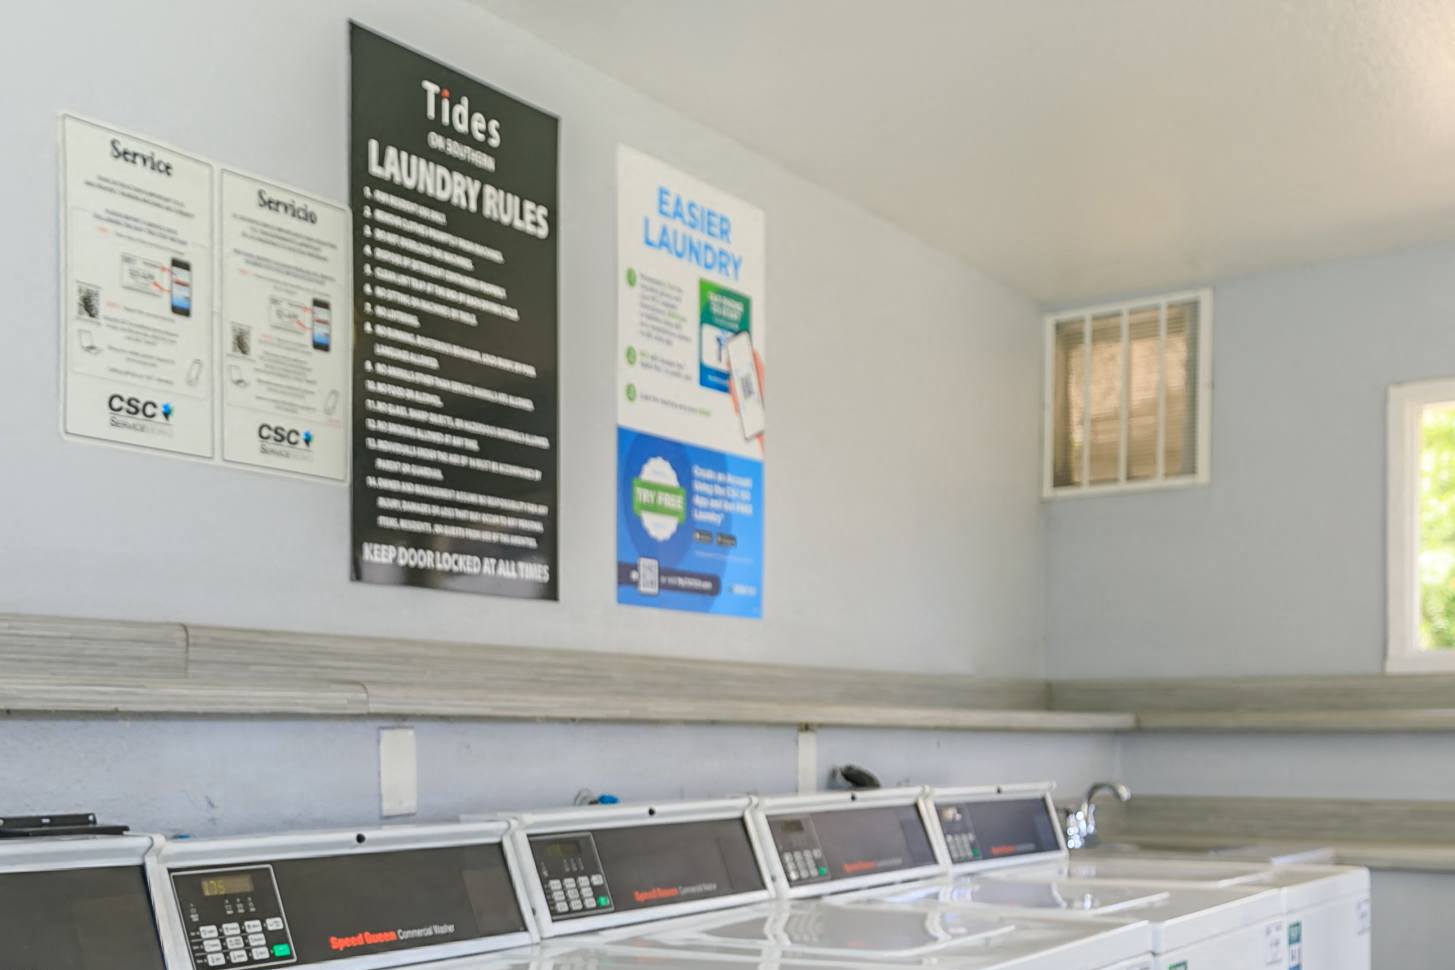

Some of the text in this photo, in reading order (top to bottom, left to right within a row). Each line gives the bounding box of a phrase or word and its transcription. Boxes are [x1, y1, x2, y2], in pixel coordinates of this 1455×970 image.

[421, 80, 501, 148] Tides
[110, 138, 173, 177] Service
[257, 189, 317, 225] Servicio
[368, 138, 481, 213] LAUNDRY
[483, 182, 549, 239] RULES
[656, 185, 732, 245] EASIER
[643, 215, 743, 281] LAUNDRY
[108, 394, 157, 420] CSC
[258, 423, 299, 446] CSC
[636, 487, 684, 510] TRY FREE
[362, 542, 550, 583] KEEP DOOR LOCKED AT ALL TIMES
